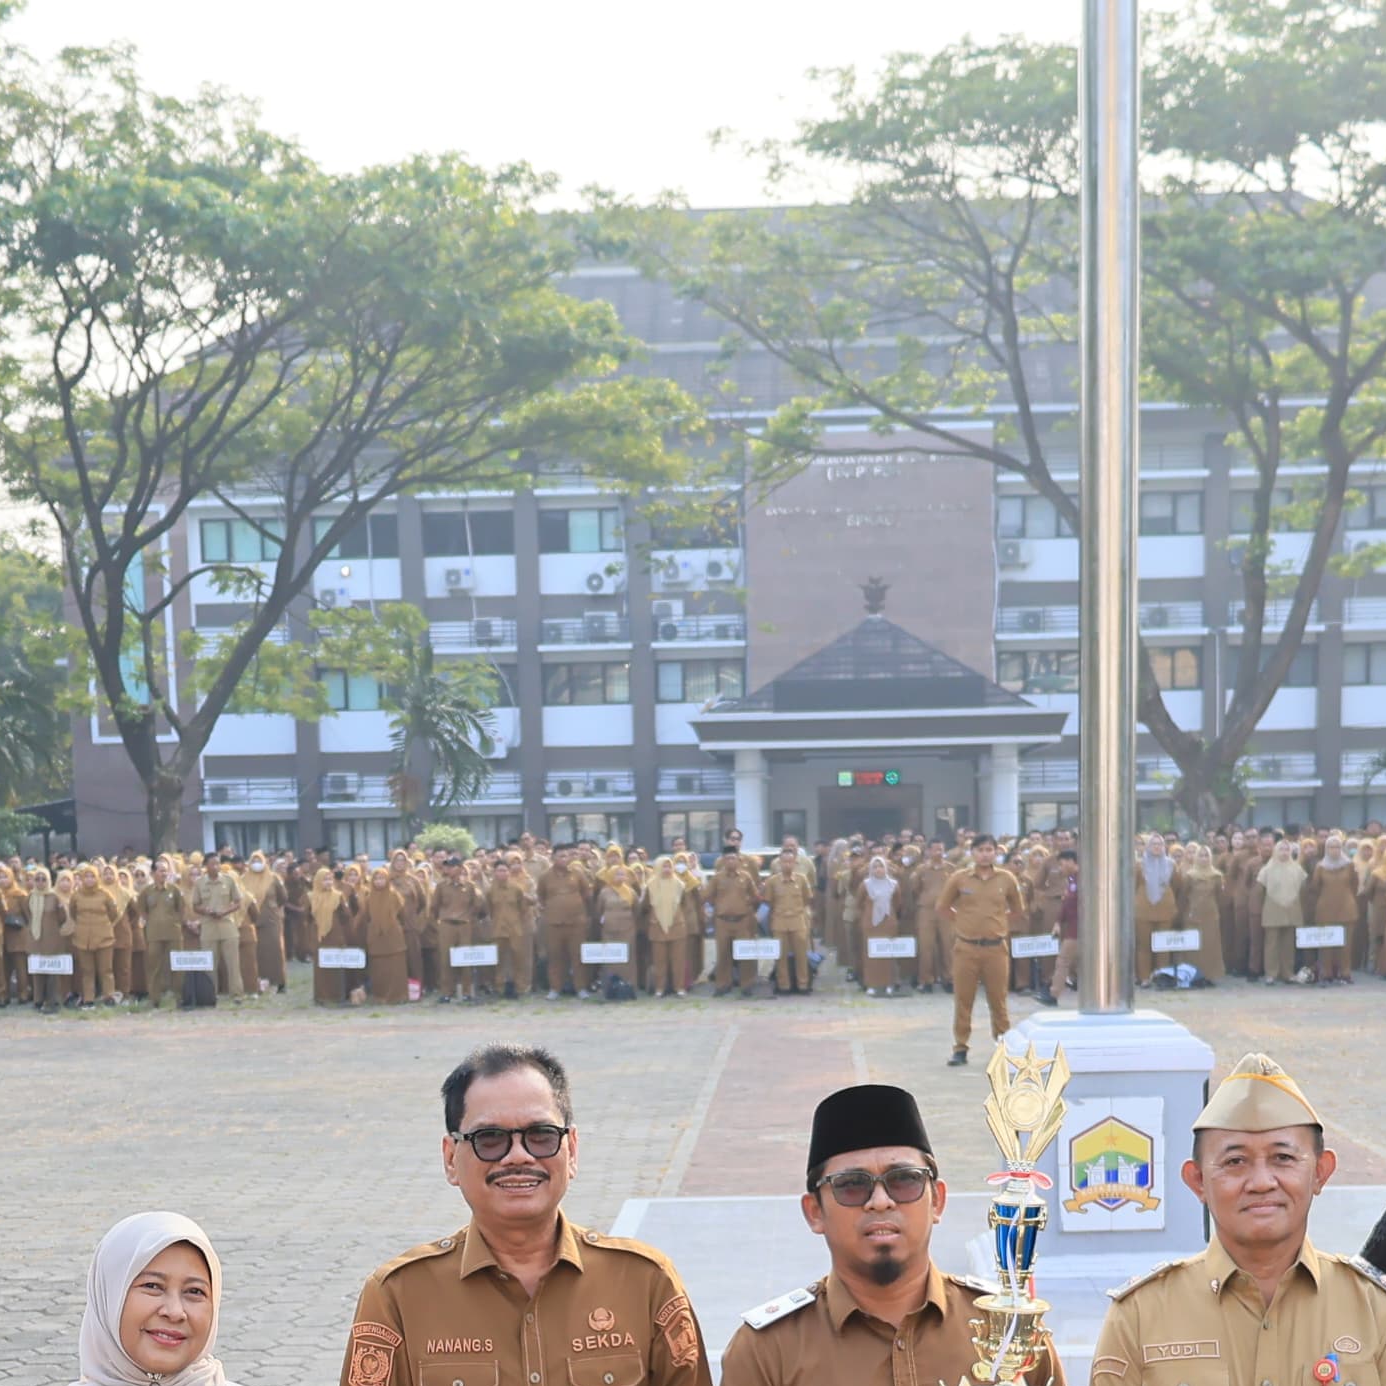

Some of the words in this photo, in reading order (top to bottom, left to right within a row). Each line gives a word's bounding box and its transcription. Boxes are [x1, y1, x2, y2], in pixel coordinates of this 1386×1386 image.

[427, 1338, 494, 1354] NANANG.S
[572, 1332, 635, 1352] SEKDA
[1157, 1343, 1200, 1358] YUDI
